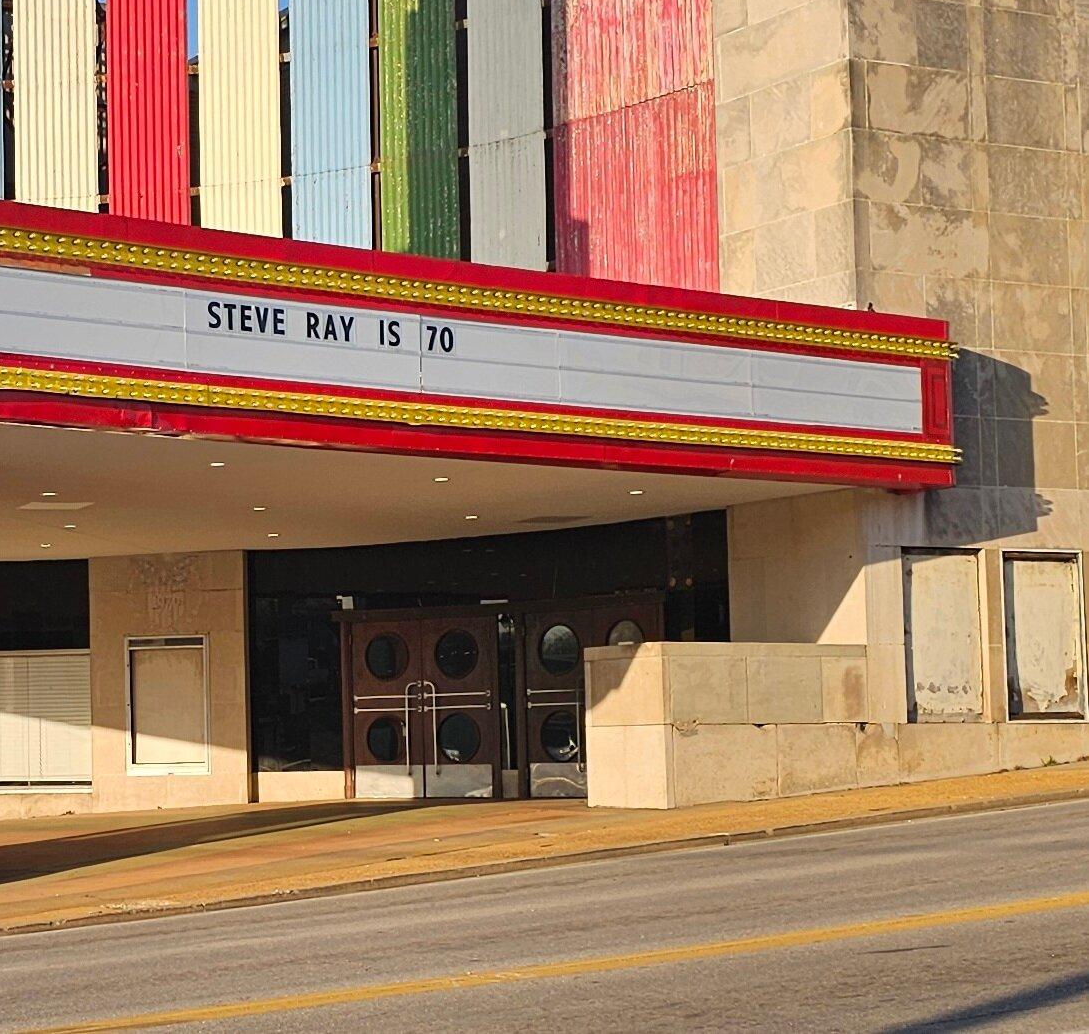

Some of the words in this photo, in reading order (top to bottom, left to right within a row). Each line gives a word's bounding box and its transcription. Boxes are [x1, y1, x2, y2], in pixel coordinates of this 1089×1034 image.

[207, 301, 286, 335] STEVE
[306, 311, 355, 342] RAY
[379, 319, 401, 347] IS
[426, 325, 454, 353] 70
